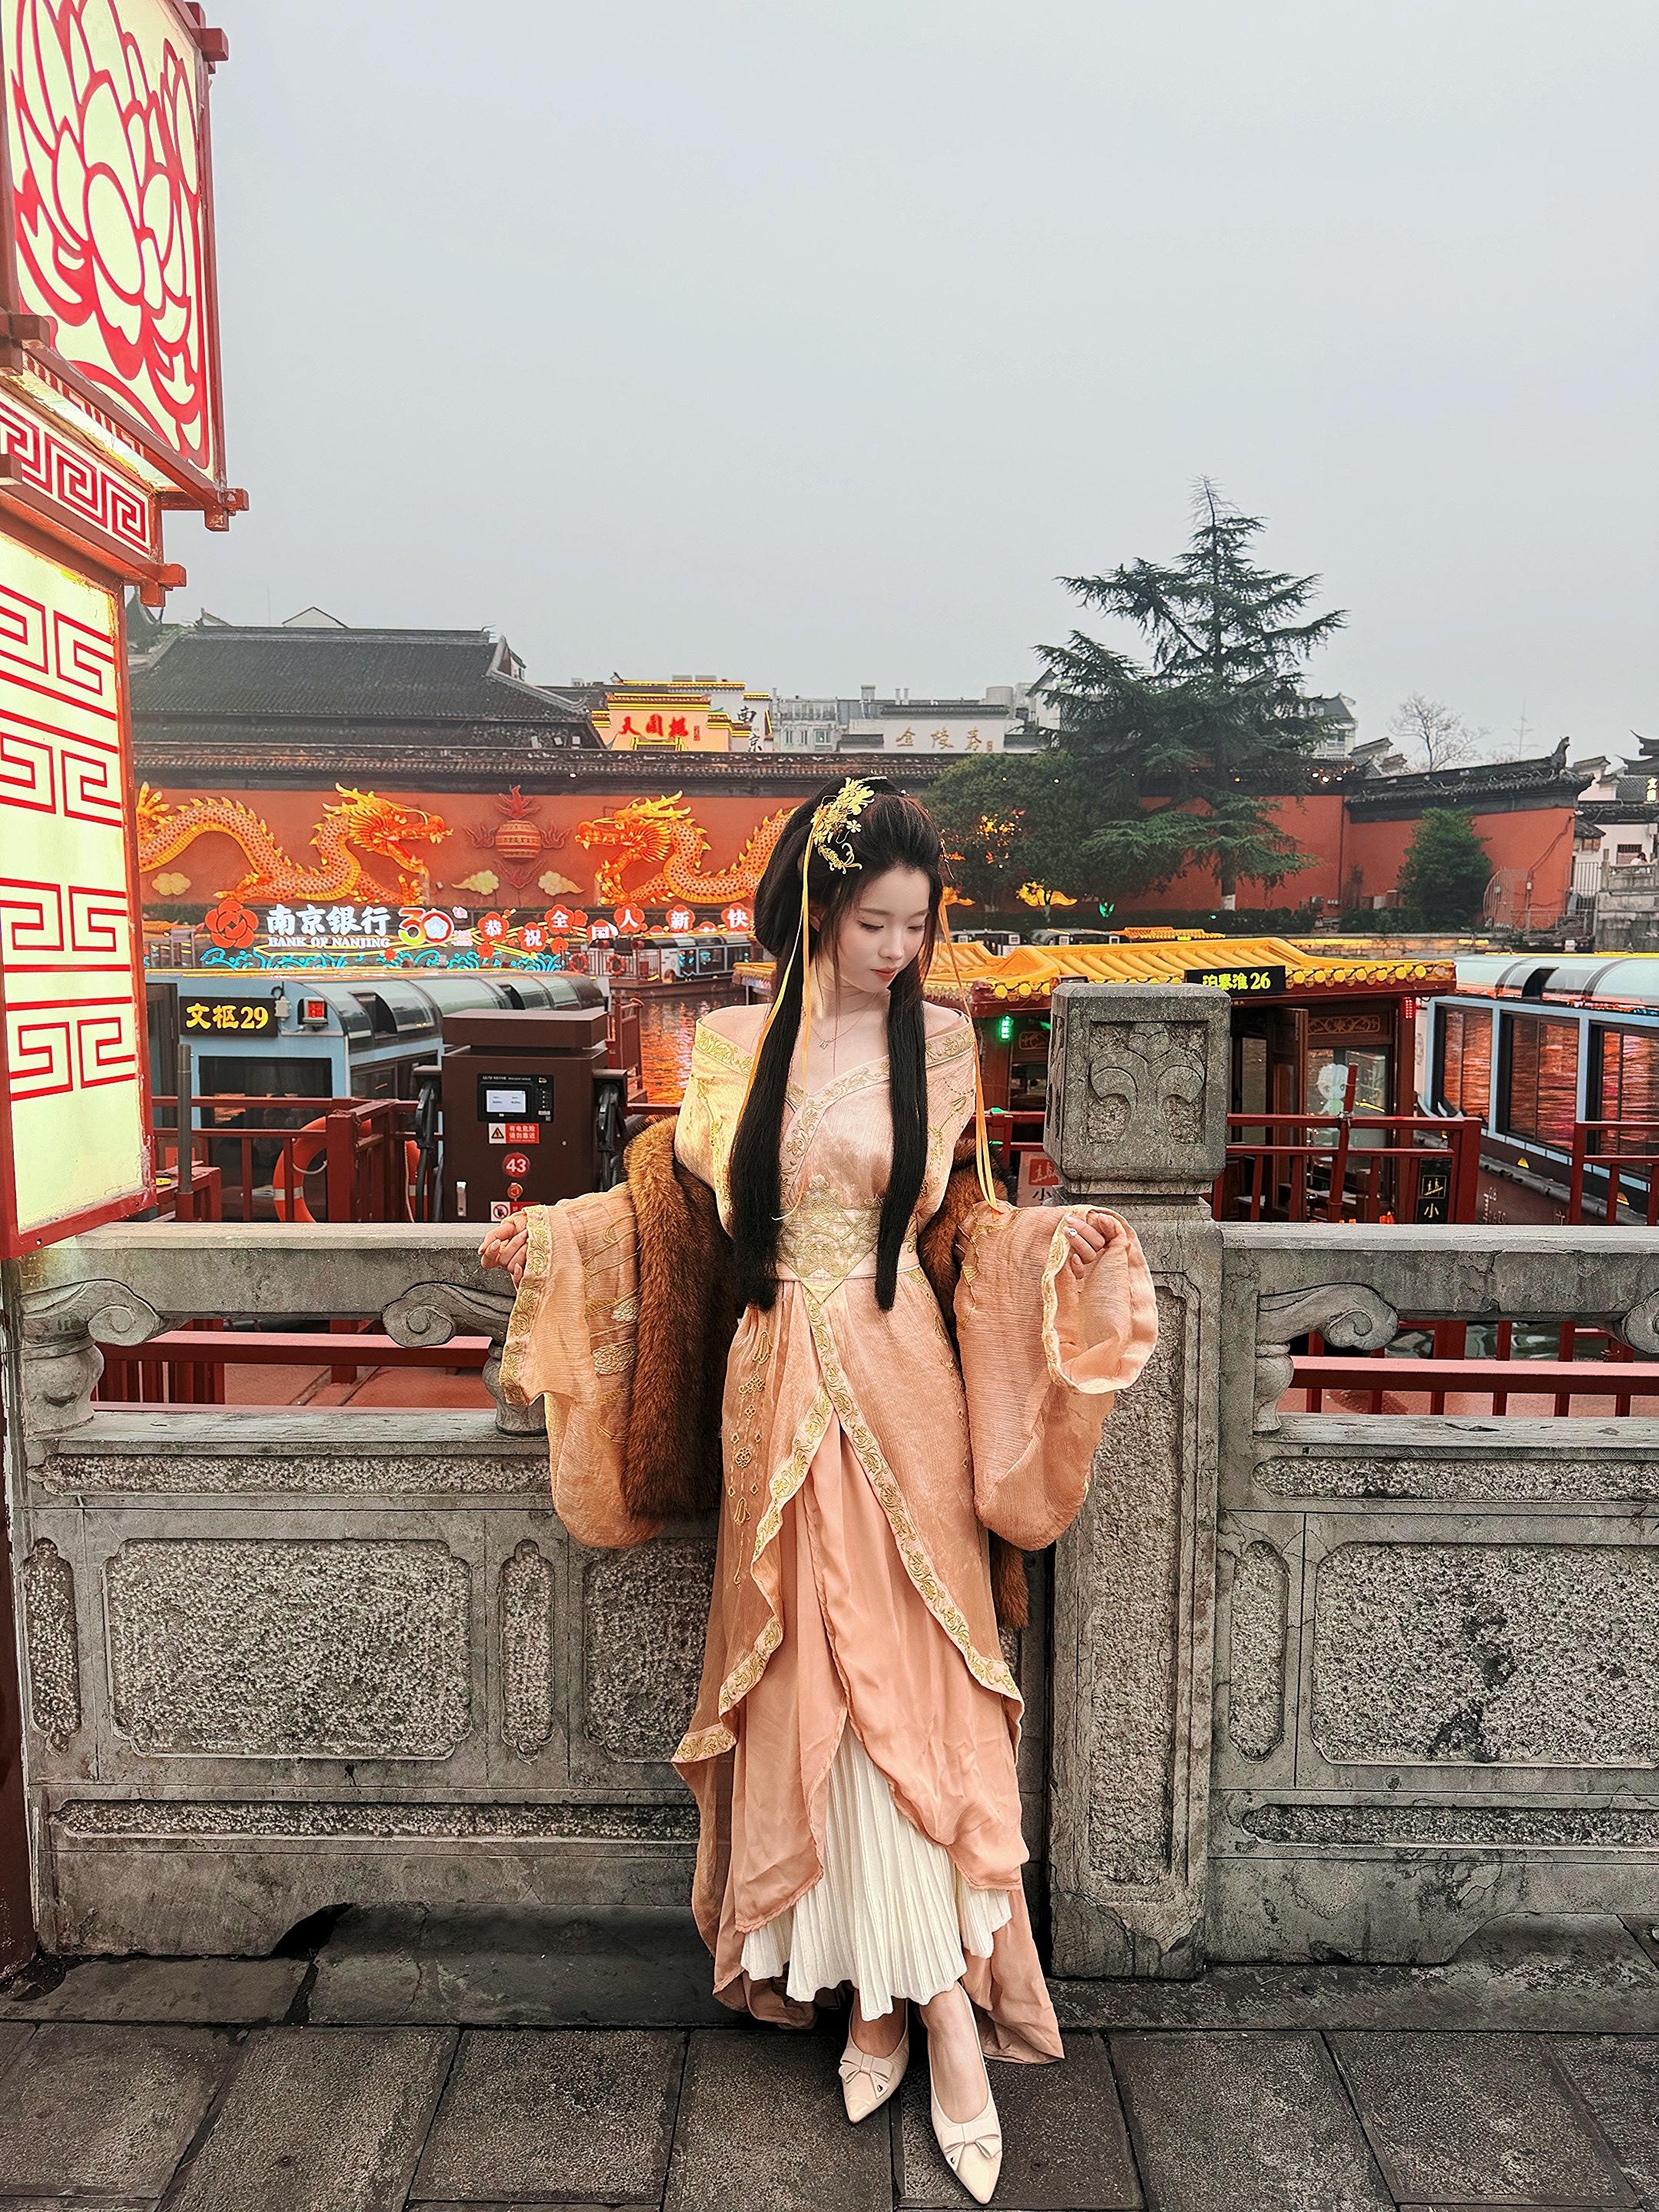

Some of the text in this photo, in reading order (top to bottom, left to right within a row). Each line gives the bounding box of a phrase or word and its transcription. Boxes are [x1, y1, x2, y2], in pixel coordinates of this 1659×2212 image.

[268, 937, 390, 949] BANK OF NANJING
[186, 1002, 269, 1029] 文枢29
[506, 1158, 527, 1173] 43
[1032, 1187, 1052, 1205] 小
[1424, 1203, 1439, 1218] 小
